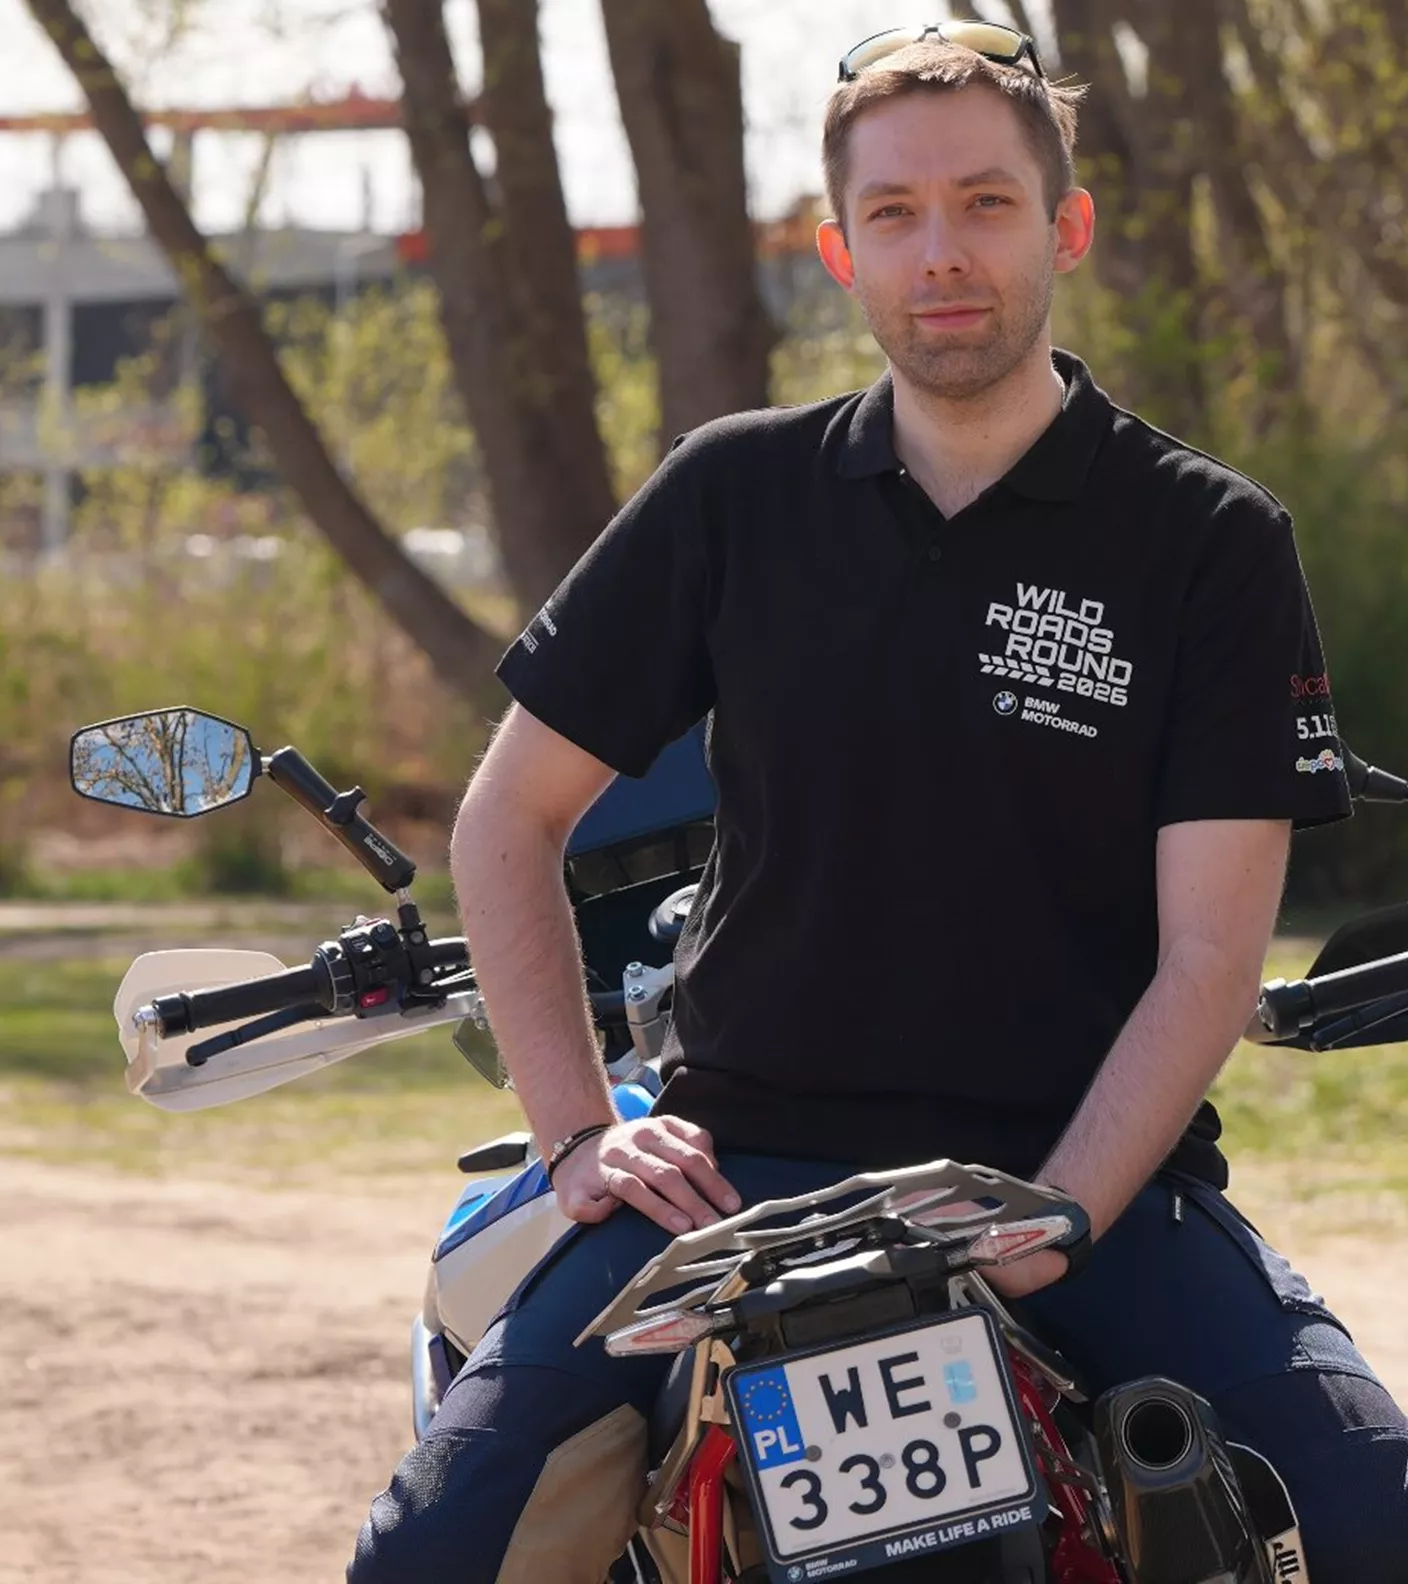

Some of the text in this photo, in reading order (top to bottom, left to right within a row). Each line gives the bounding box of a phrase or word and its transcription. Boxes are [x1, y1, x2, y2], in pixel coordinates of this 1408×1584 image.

[985, 602, 1114, 654] ROADS
[1016, 582, 1105, 626] WILD
[1004, 633, 1133, 686] ROUND
[1024, 696, 1061, 715] BMW
[1056, 672, 1129, 707] 2026
[1020, 709, 1099, 739] MOTORRAD
[817, 1351, 932, 1435] WE
[753, 1425, 801, 1461] PL
[779, 1424, 1002, 1531] 338P
[884, 1505, 1033, 1558] MAKE LIFE A RIDE
